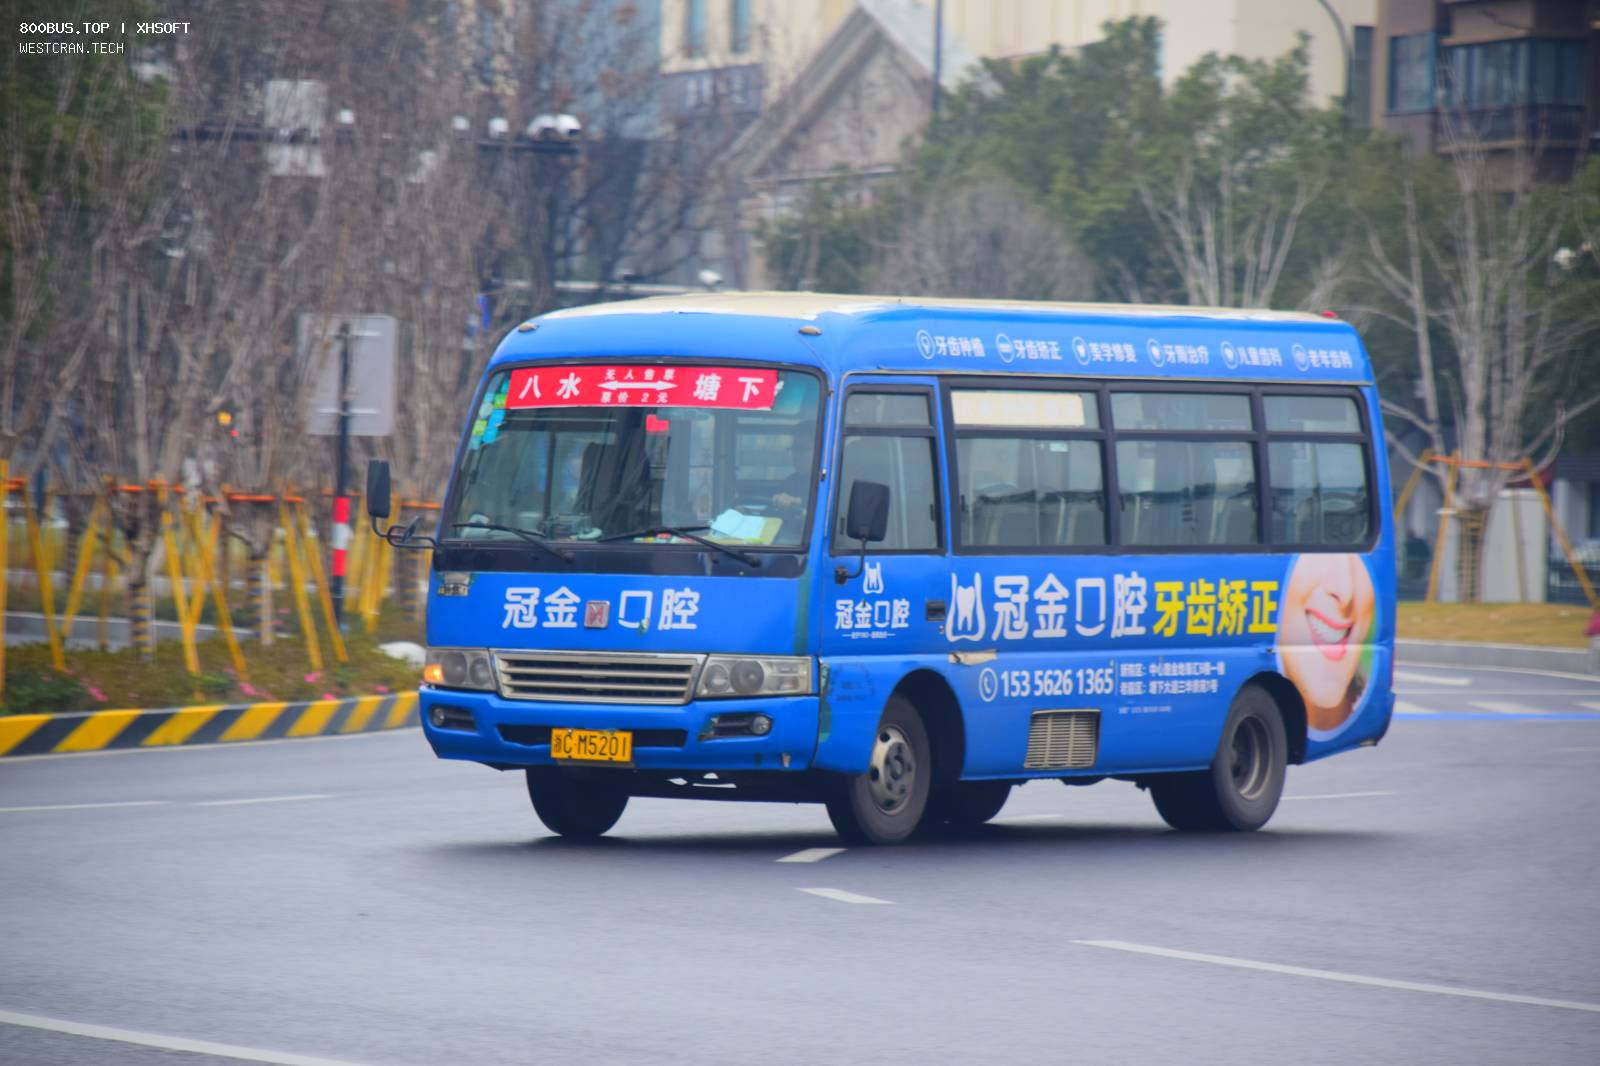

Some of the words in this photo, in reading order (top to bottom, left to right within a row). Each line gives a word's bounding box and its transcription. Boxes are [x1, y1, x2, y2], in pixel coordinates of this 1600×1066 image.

[935, 336, 985, 357] 牙齿种植
[1013, 340, 1062, 360] 牙齿矫正
[835, 598, 910, 630] 冠金口腔
[992, 571, 1147, 640] 冠金口腔
[1153, 578, 1279, 637] 牙齿矫正
[1001, 671, 1030, 697] 153
[1034, 669, 1073, 696] 5626
[1076, 668, 1114, 695] 1365
